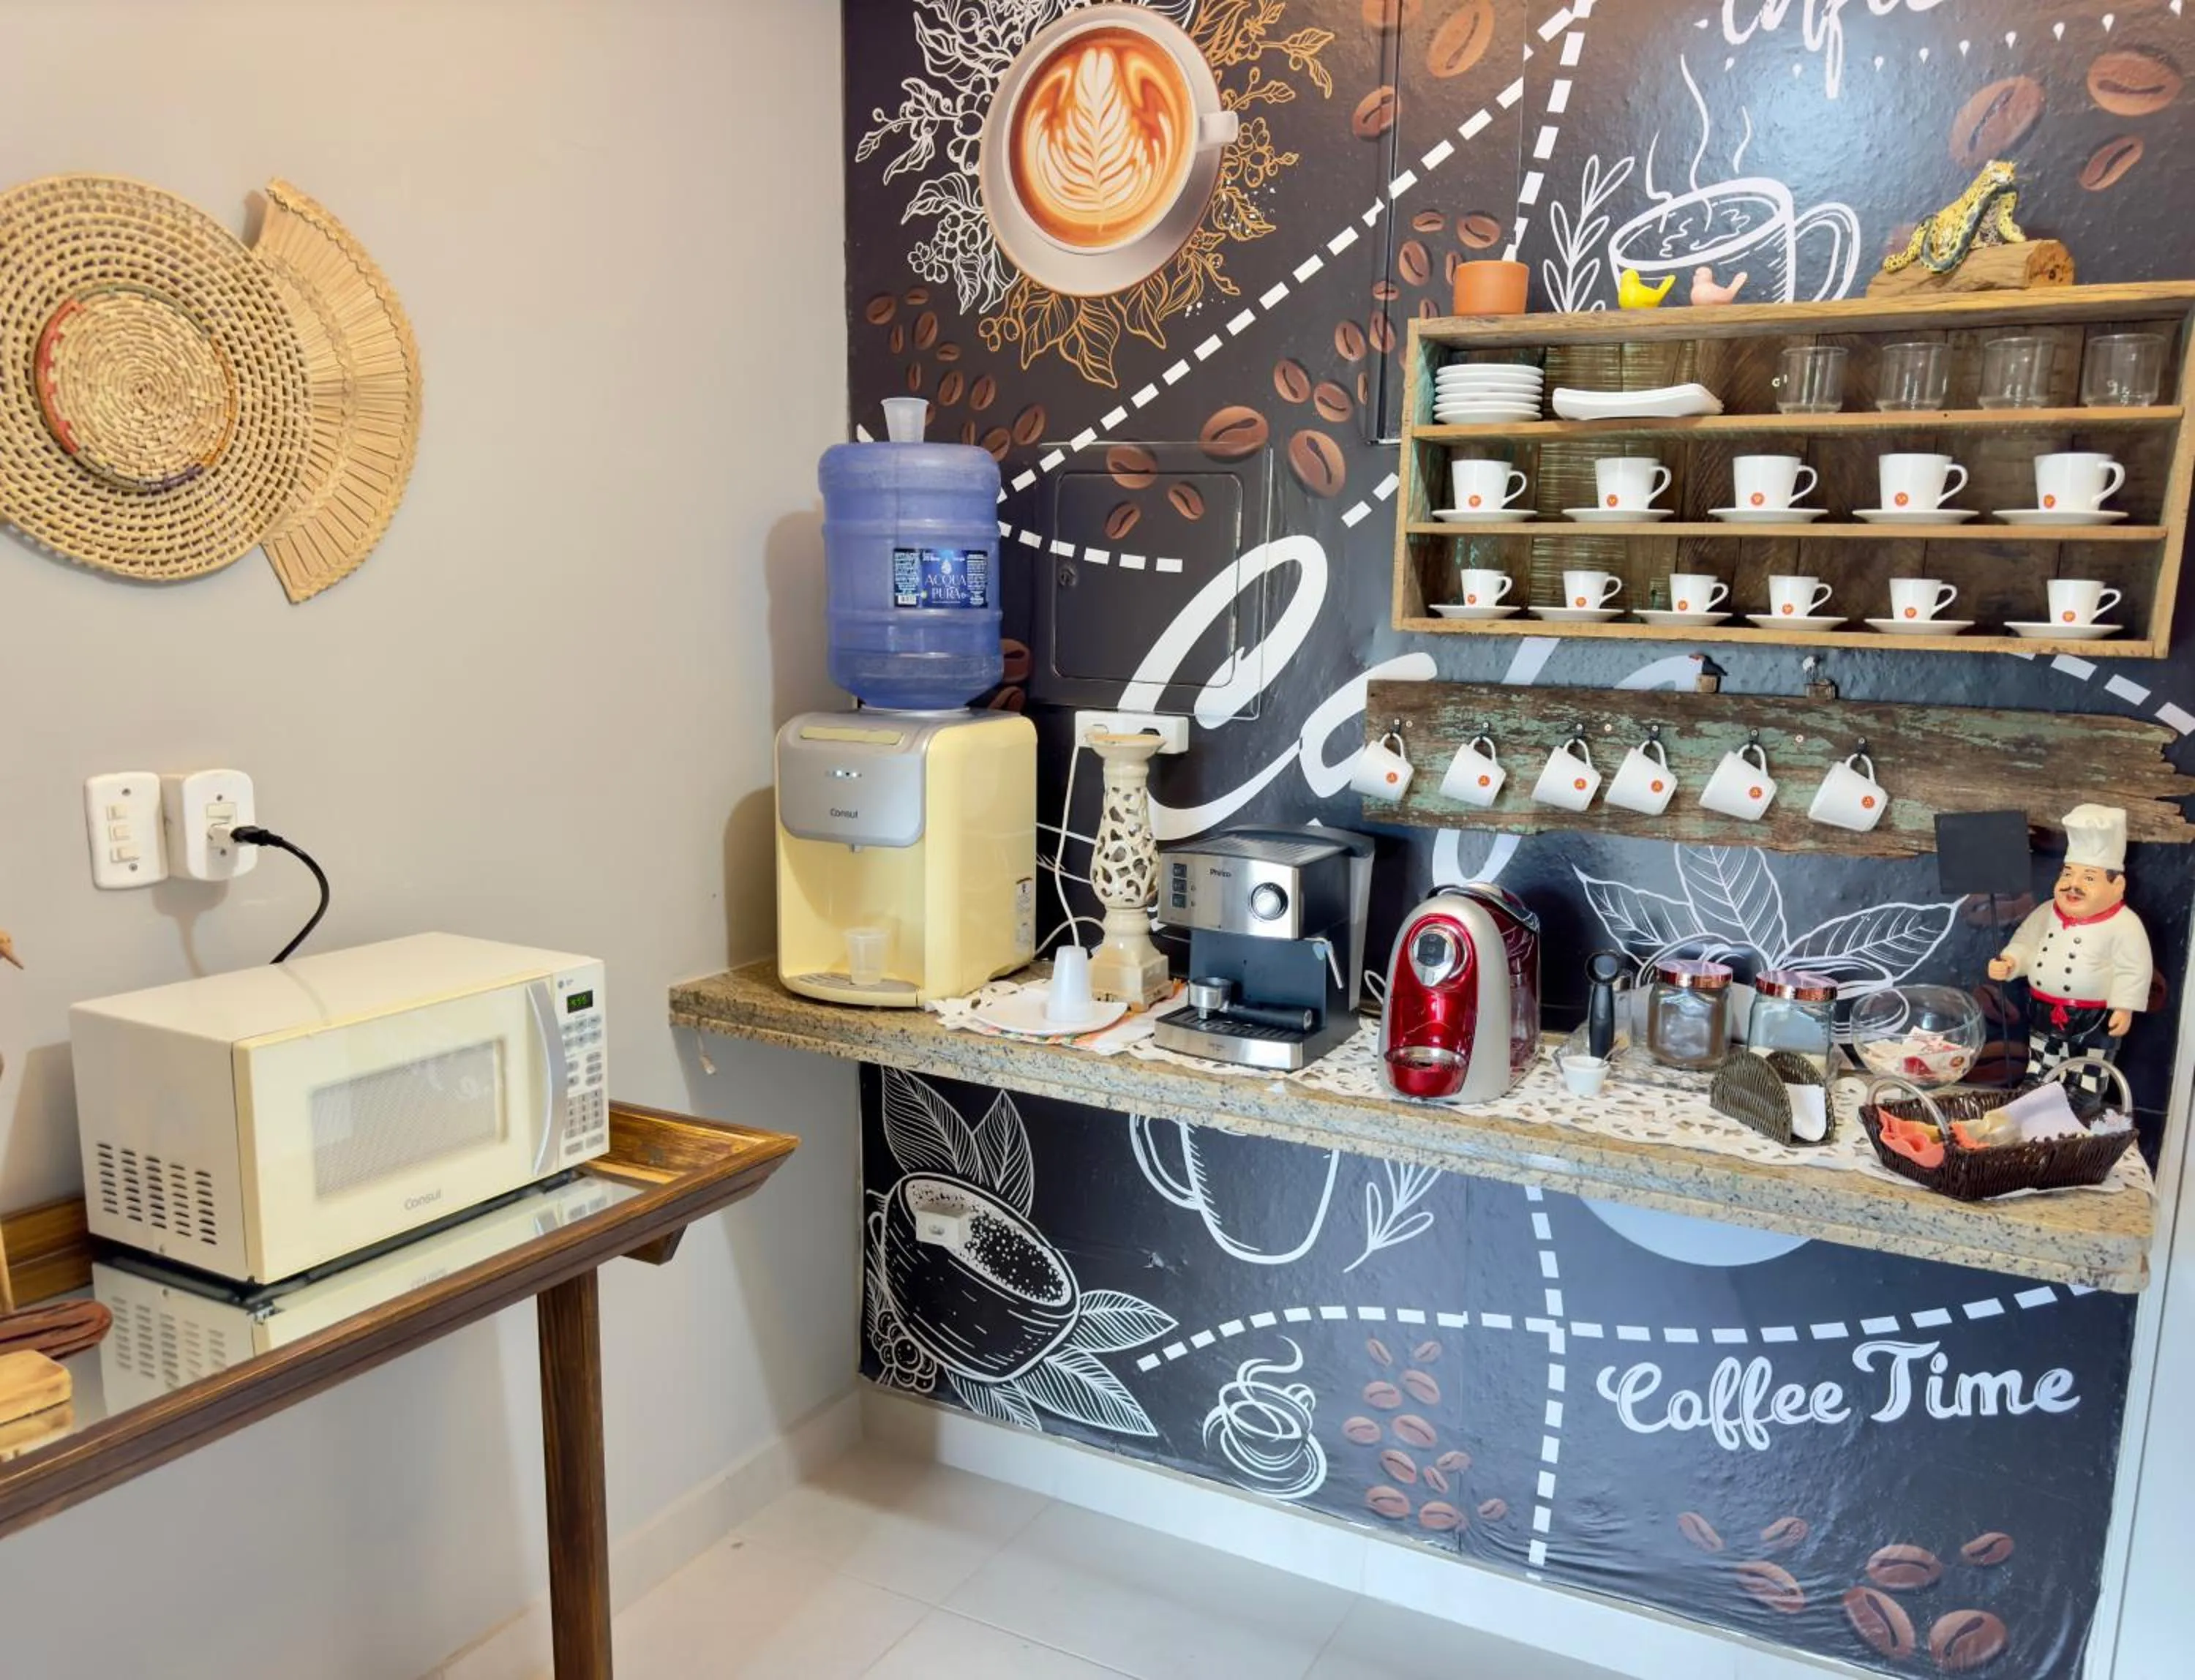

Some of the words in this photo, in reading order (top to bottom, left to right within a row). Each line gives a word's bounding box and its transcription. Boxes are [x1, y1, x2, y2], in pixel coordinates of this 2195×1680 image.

[925, 574, 967, 587] ACQUA
[931, 587, 961, 599] PURA
[830, 807, 858, 819] Consul
[404, 1188, 441, 1211] Consul
[1596, 1356, 1851, 1451] Coffee
[1852, 1340, 2081, 1422] Time
